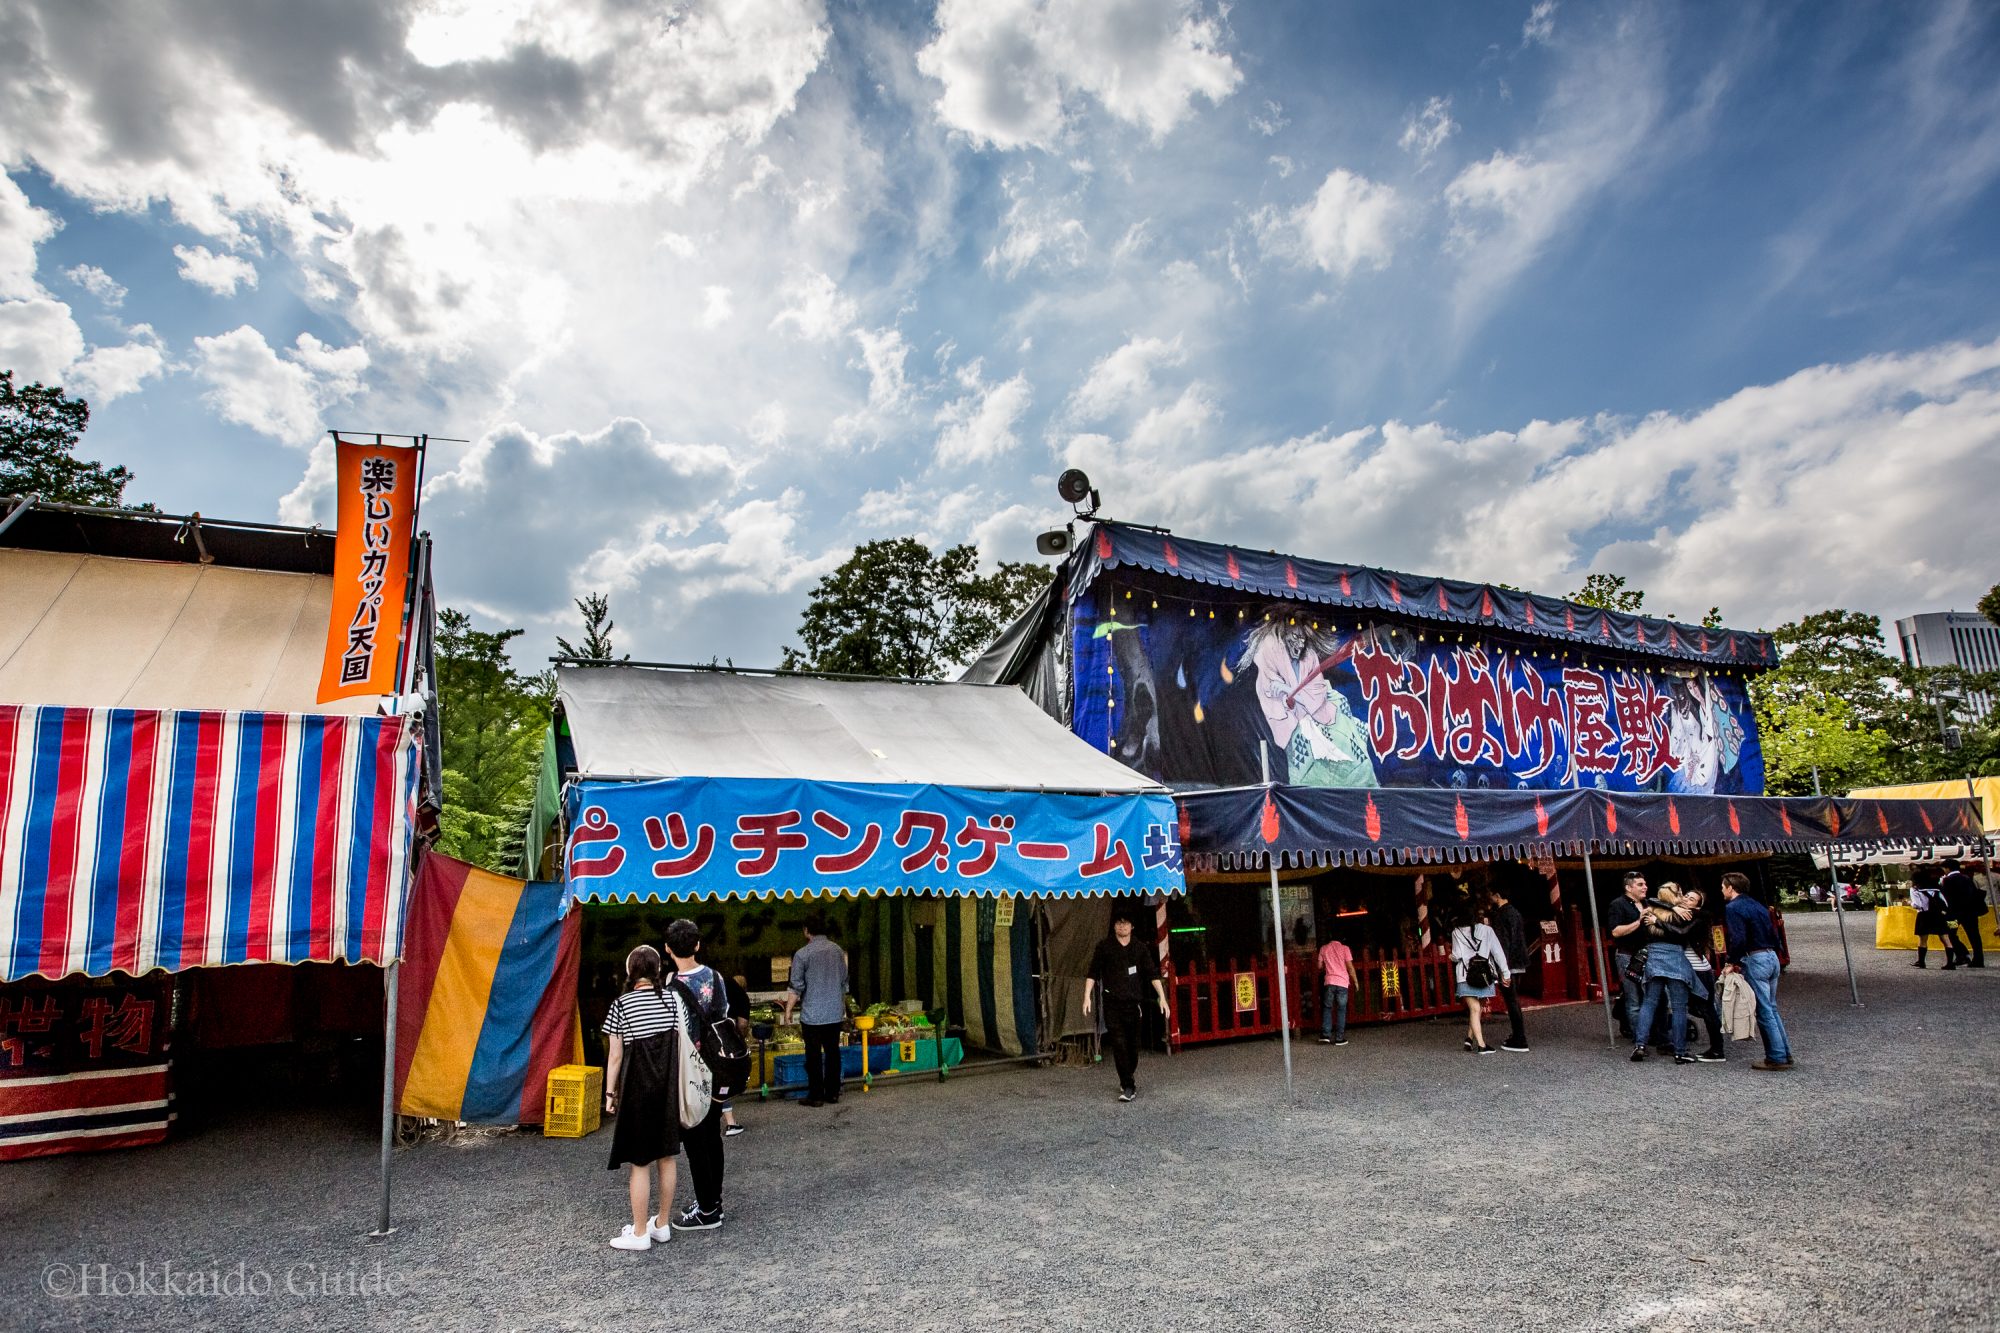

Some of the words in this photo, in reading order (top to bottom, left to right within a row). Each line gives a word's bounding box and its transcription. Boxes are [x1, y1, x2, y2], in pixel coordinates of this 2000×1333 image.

[341, 457, 396, 685] 楽しいカッパ天国
[1352, 620, 1685, 785] おばけ屋敷
